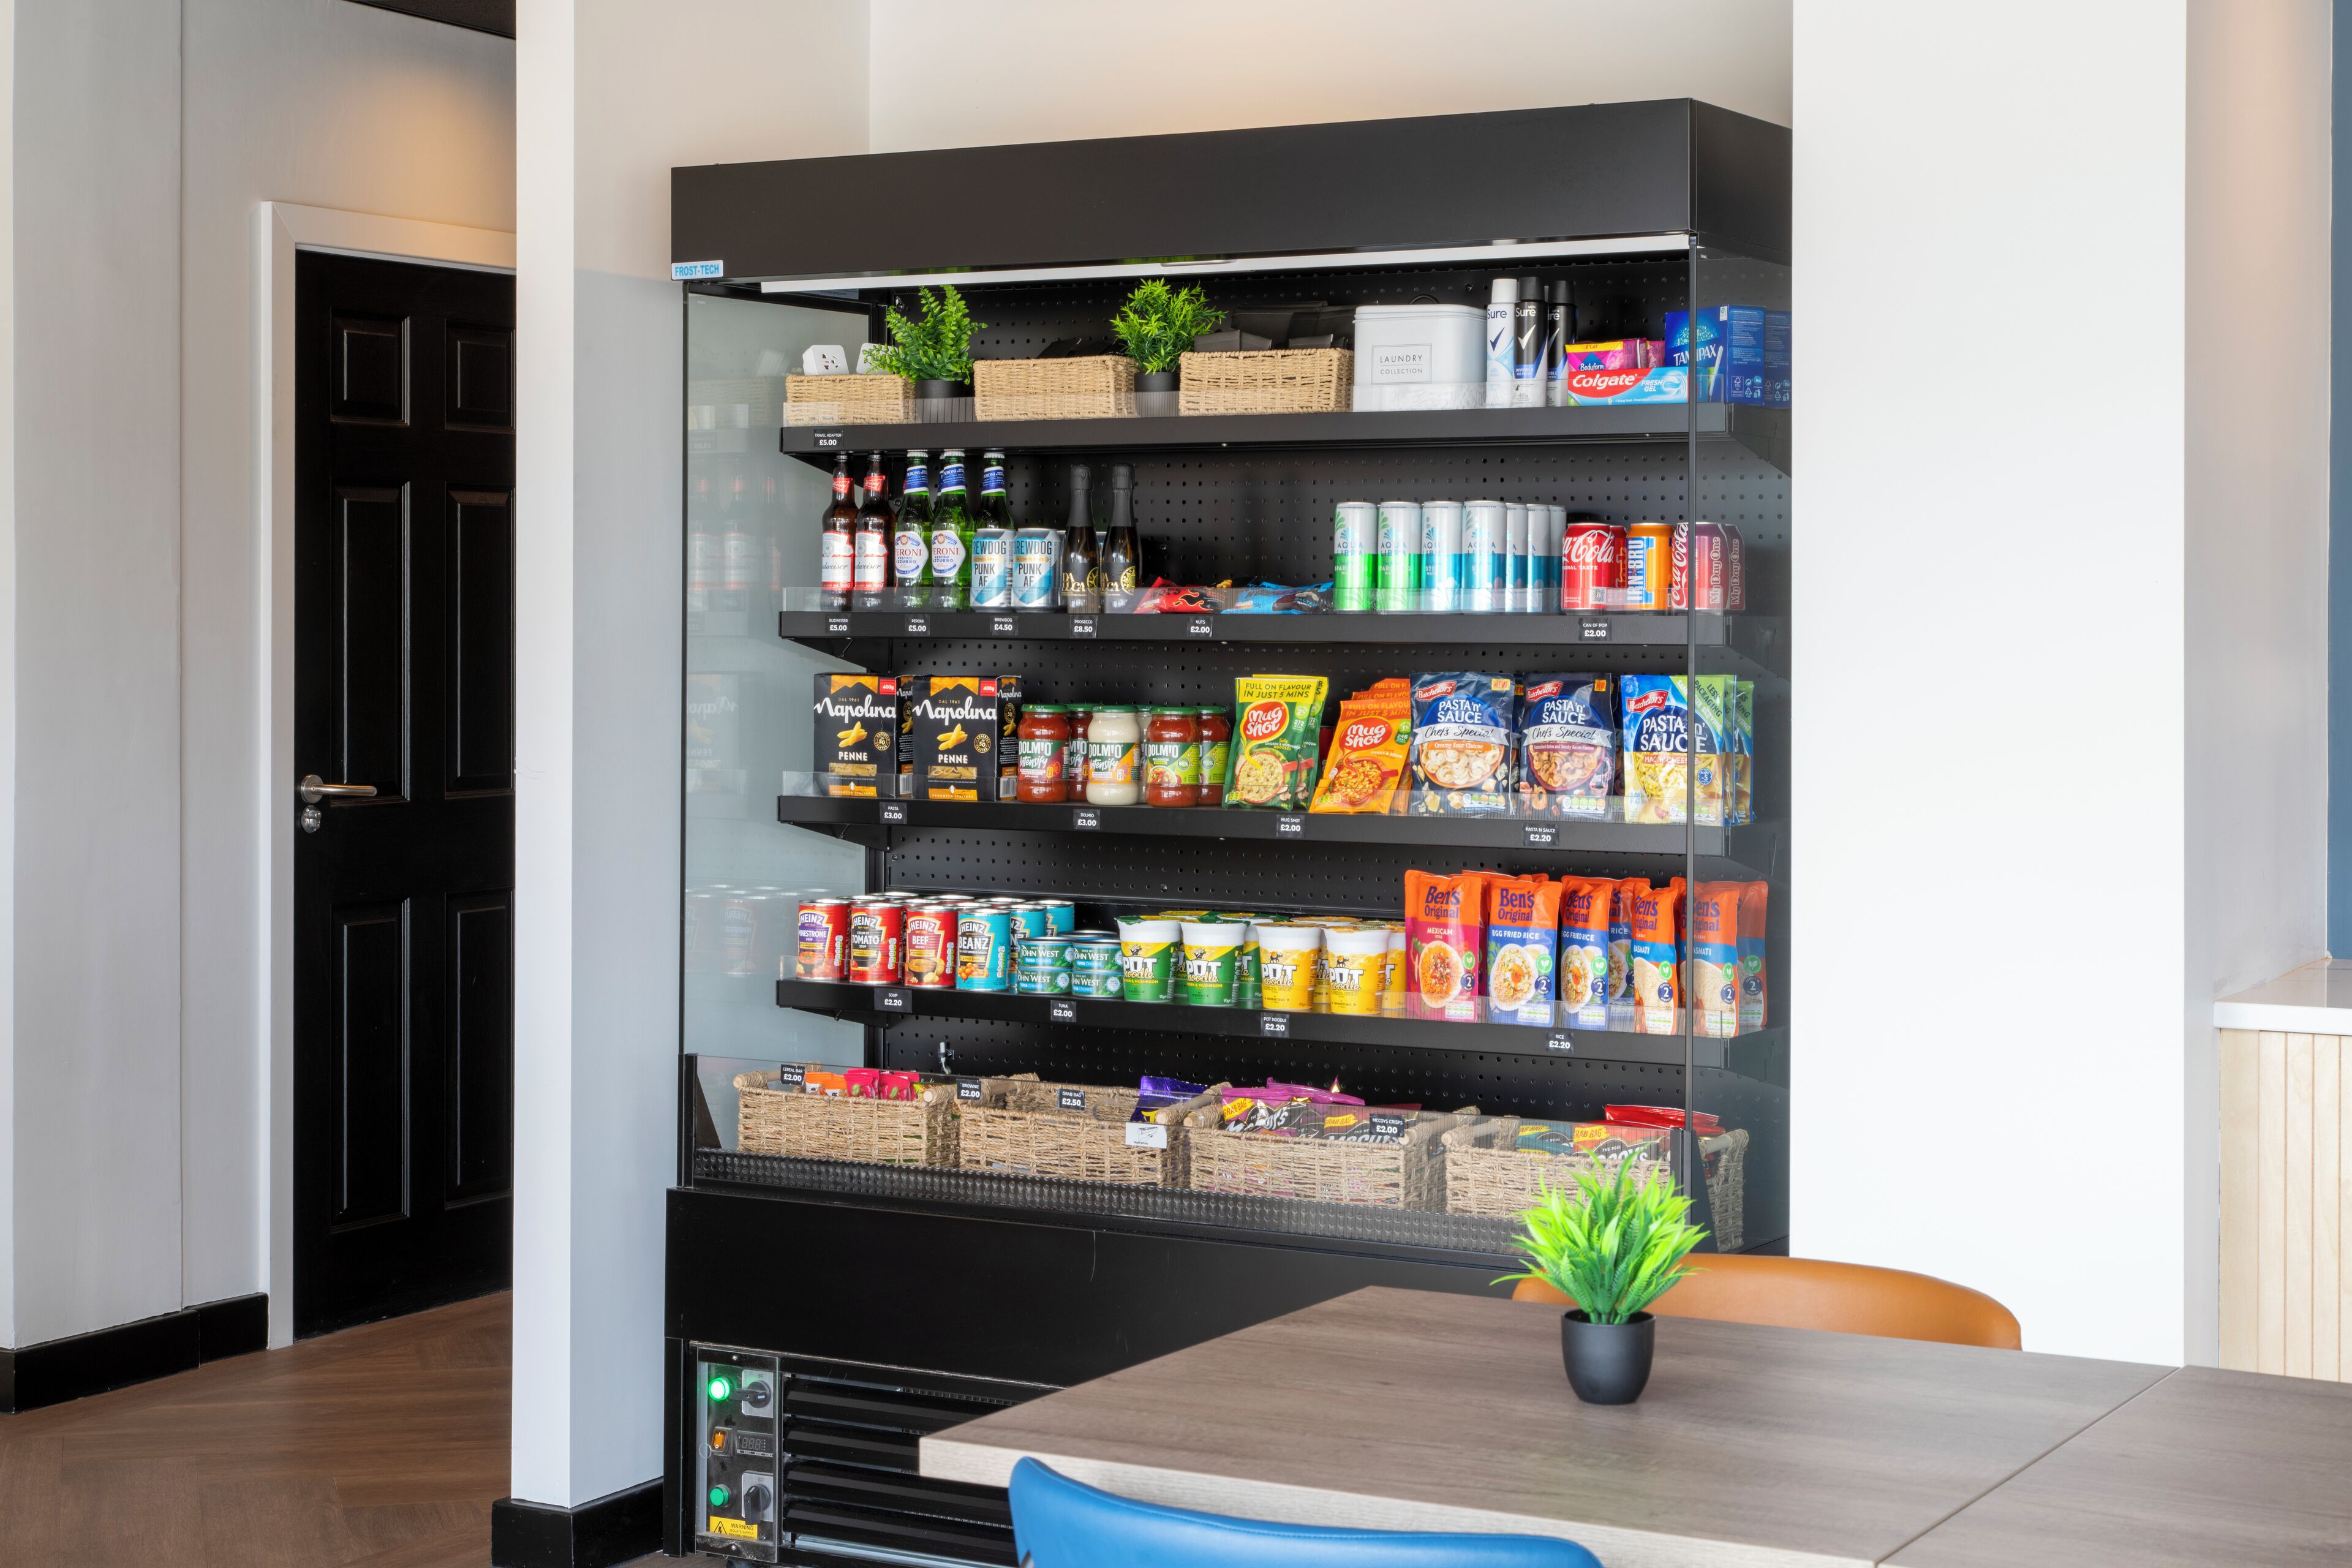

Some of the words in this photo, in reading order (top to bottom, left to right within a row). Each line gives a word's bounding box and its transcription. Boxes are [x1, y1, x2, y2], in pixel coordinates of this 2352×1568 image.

[674, 264, 719, 277] FROST-TECH
[1488, 309, 1507, 318] Sure
[1516, 308, 1536, 317] Sure
[1573, 374, 1635, 390] Colgate
[1562, 530, 1614, 563] a-Cola
[975, 564, 995, 575] PUNK
[1019, 564, 1041, 575] PUNK
[1024, 576, 1034, 587] AF
[1063, 573, 1075, 582] DA
[1061, 582, 1085, 592] LUCA
[1295, 597, 1317, 607] SALTED
[1419, 684, 1452, 698] Batchelors
[1528, 685, 1558, 699] Batchelors
[1706, 684, 1720, 701] LESS
[1439, 699, 1471, 710] PASTA
[1695, 680, 1722, 718] PACKAGING
[814, 694, 896, 723] Napolina
[912, 696, 997, 726] Napolina
[1248, 707, 1283, 723] Mug
[1438, 711, 1482, 723] SAUCE
[1542, 711, 1585, 724] SAUCE
[1246, 719, 1280, 737] Shot
[1348, 725, 1386, 737] Mug
[1425, 726, 1449, 738] Chef's
[1454, 725, 1494, 737] Special
[1532, 726, 1553, 740] Chef's
[1556, 726, 1596, 740] Special
[1345, 734, 1382, 747] Shot
[1019, 741, 1052, 756] DOLMIO
[1089, 744, 1121, 758] DOLMIO
[839, 752, 867, 761] PENNE
[938, 755, 968, 764] PENNE
[1020, 755, 1048, 769] Intensify
[1090, 758, 1118, 771] Intensify
[1425, 886, 1461, 906] Ben's
[1499, 888, 1535, 908] Ben's
[1424, 905, 1459, 919] Original
[1498, 908, 1532, 923] Original
[801, 914, 823, 925] HEINZ
[853, 916, 877, 927] HEINZ
[910, 921, 935, 932] HEINZ
[852, 935, 880, 944] TOMATO
[912, 935, 929, 945] BEEF
[959, 937, 989, 949] BEANZ
[1021, 945, 1036, 957] JOHN
[1634, 945, 1649, 955] BASMATI
[1123, 956, 1158, 974] POT
[1124, 967, 1155, 979] noodle
[1223, 1102, 1237, 1117] GRAB
[1237, 1099, 1247, 1112] BAG
[1376, 1126, 1398, 1134] £2.00
